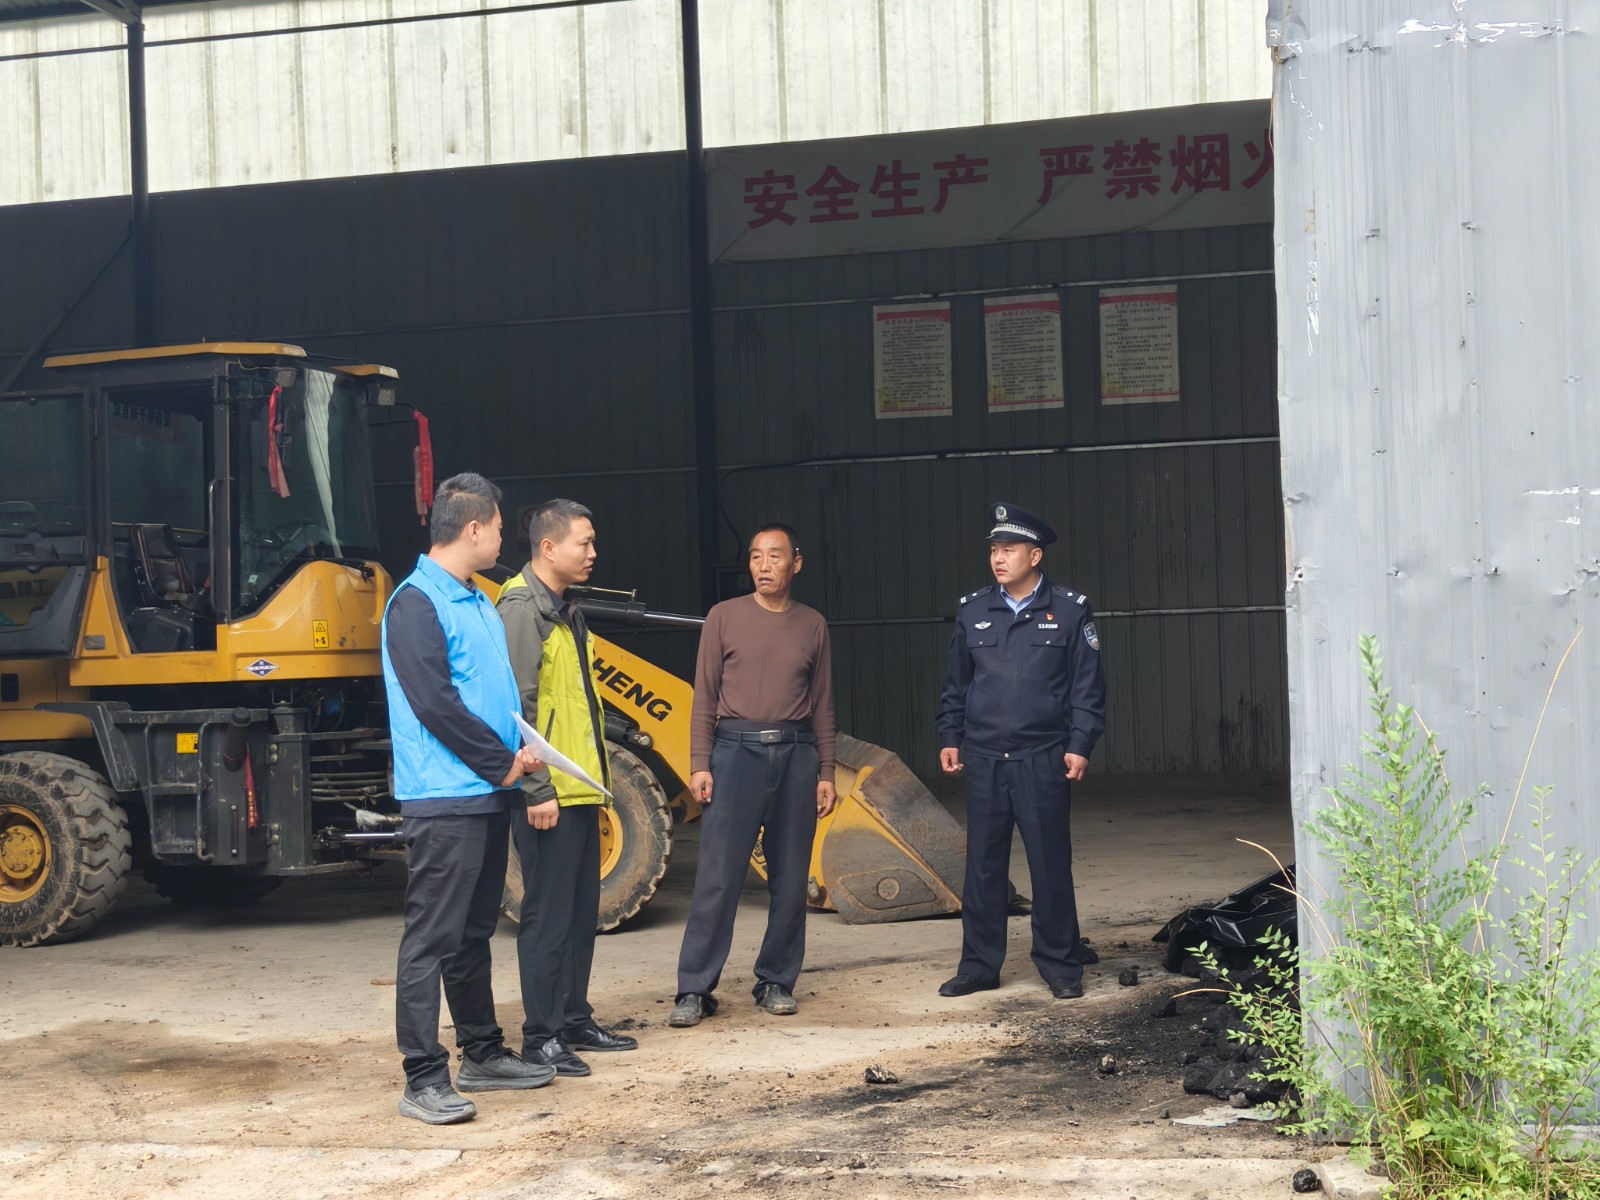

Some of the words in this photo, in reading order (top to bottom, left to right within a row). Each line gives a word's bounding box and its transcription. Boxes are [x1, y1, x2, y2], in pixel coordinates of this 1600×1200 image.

[743, 153, 989, 230] 安全生产
[1037, 129, 1275, 205] 严禁烟火
[592, 648, 673, 722] HENG
